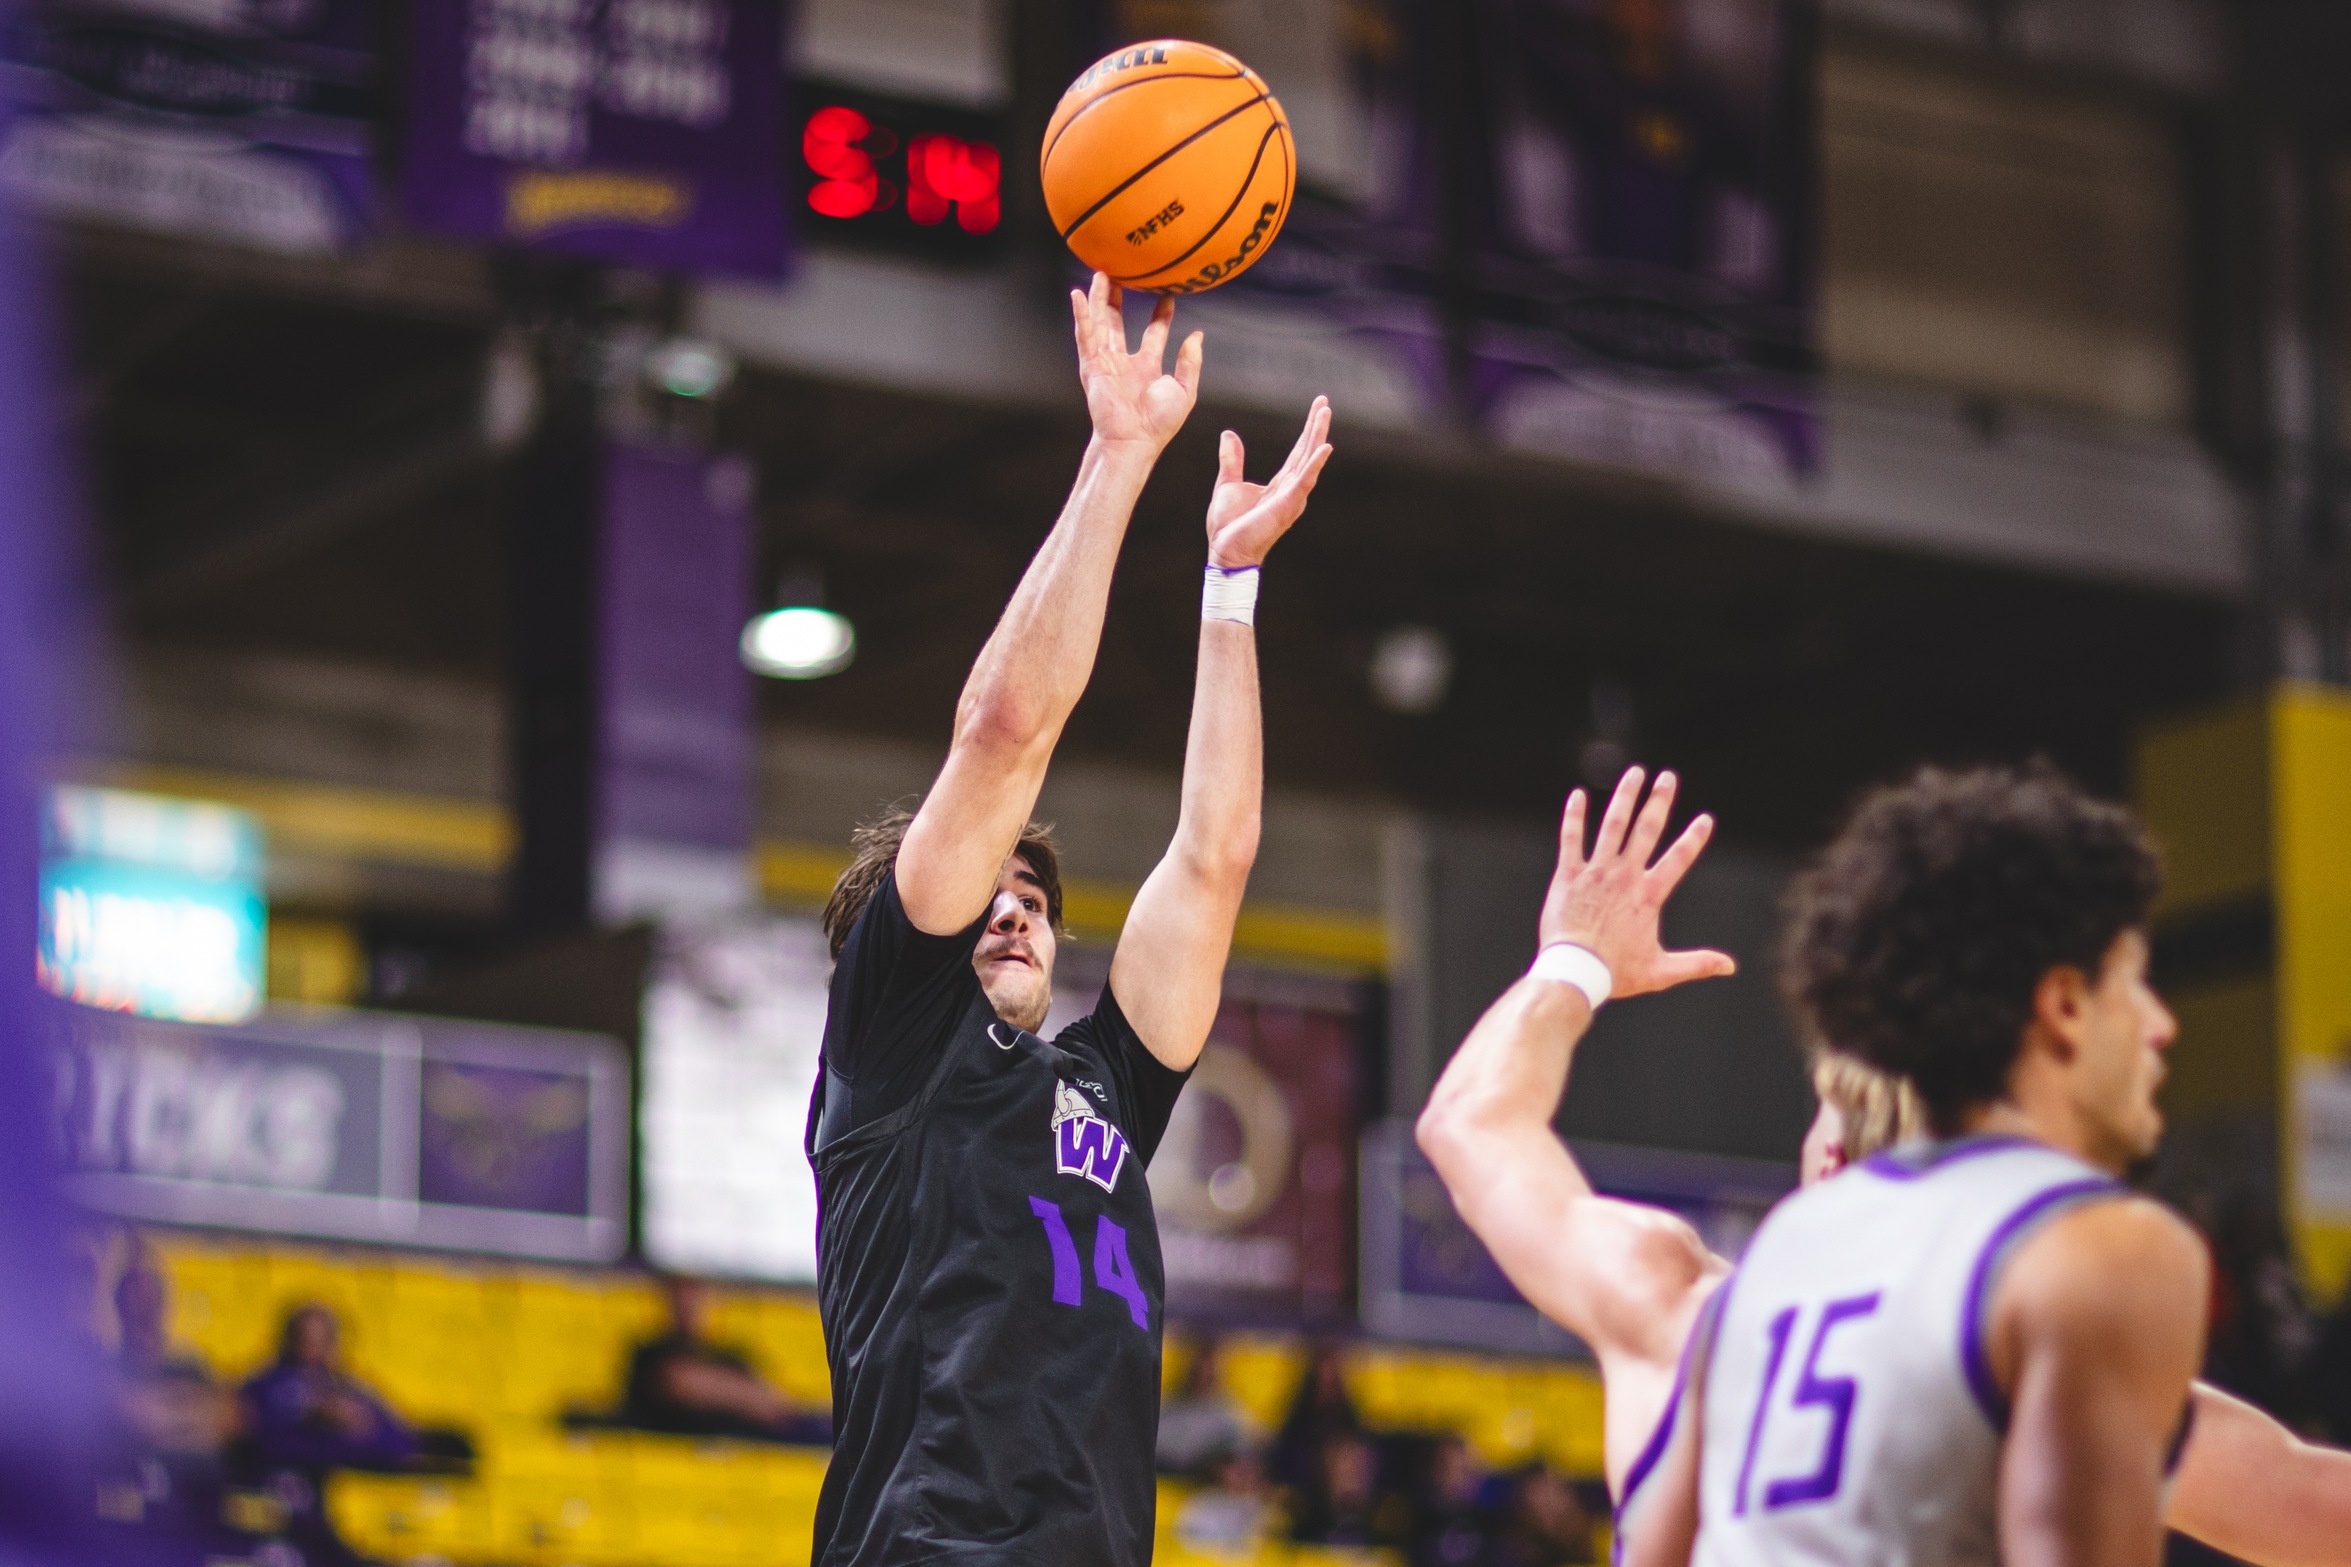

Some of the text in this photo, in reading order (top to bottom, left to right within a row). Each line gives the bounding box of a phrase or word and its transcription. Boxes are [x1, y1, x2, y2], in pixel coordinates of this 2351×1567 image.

[1137, 198, 1184, 240] NFHS
[1053, 1116, 1130, 1194] W
[1028, 1195, 1149, 1332] 14
[1733, 1292, 1880, 1517] 15
